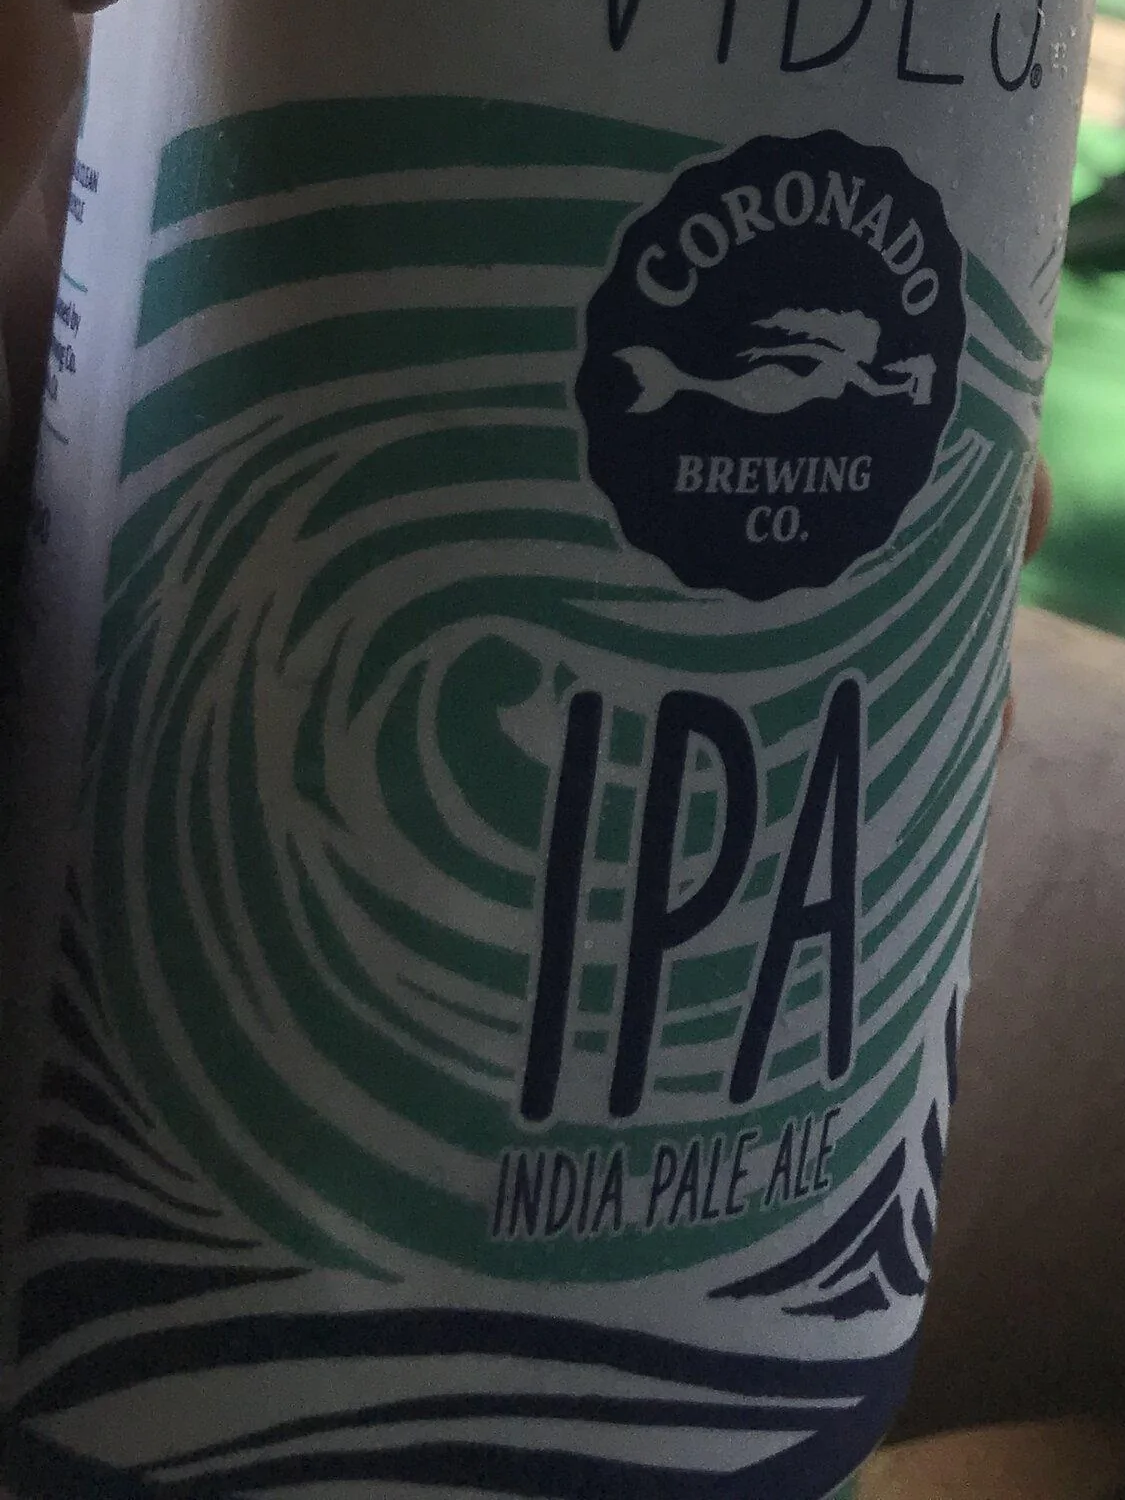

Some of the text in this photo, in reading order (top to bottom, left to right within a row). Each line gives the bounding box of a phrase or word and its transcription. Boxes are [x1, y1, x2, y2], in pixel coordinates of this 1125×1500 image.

[635, 169, 940, 317] CORONADO
[673, 454, 873, 496] BREWING
[744, 504, 810, 544] CO.
[519, 677, 862, 1123] IPA
[491, 1107, 841, 1238] INDIA PALE ALE
